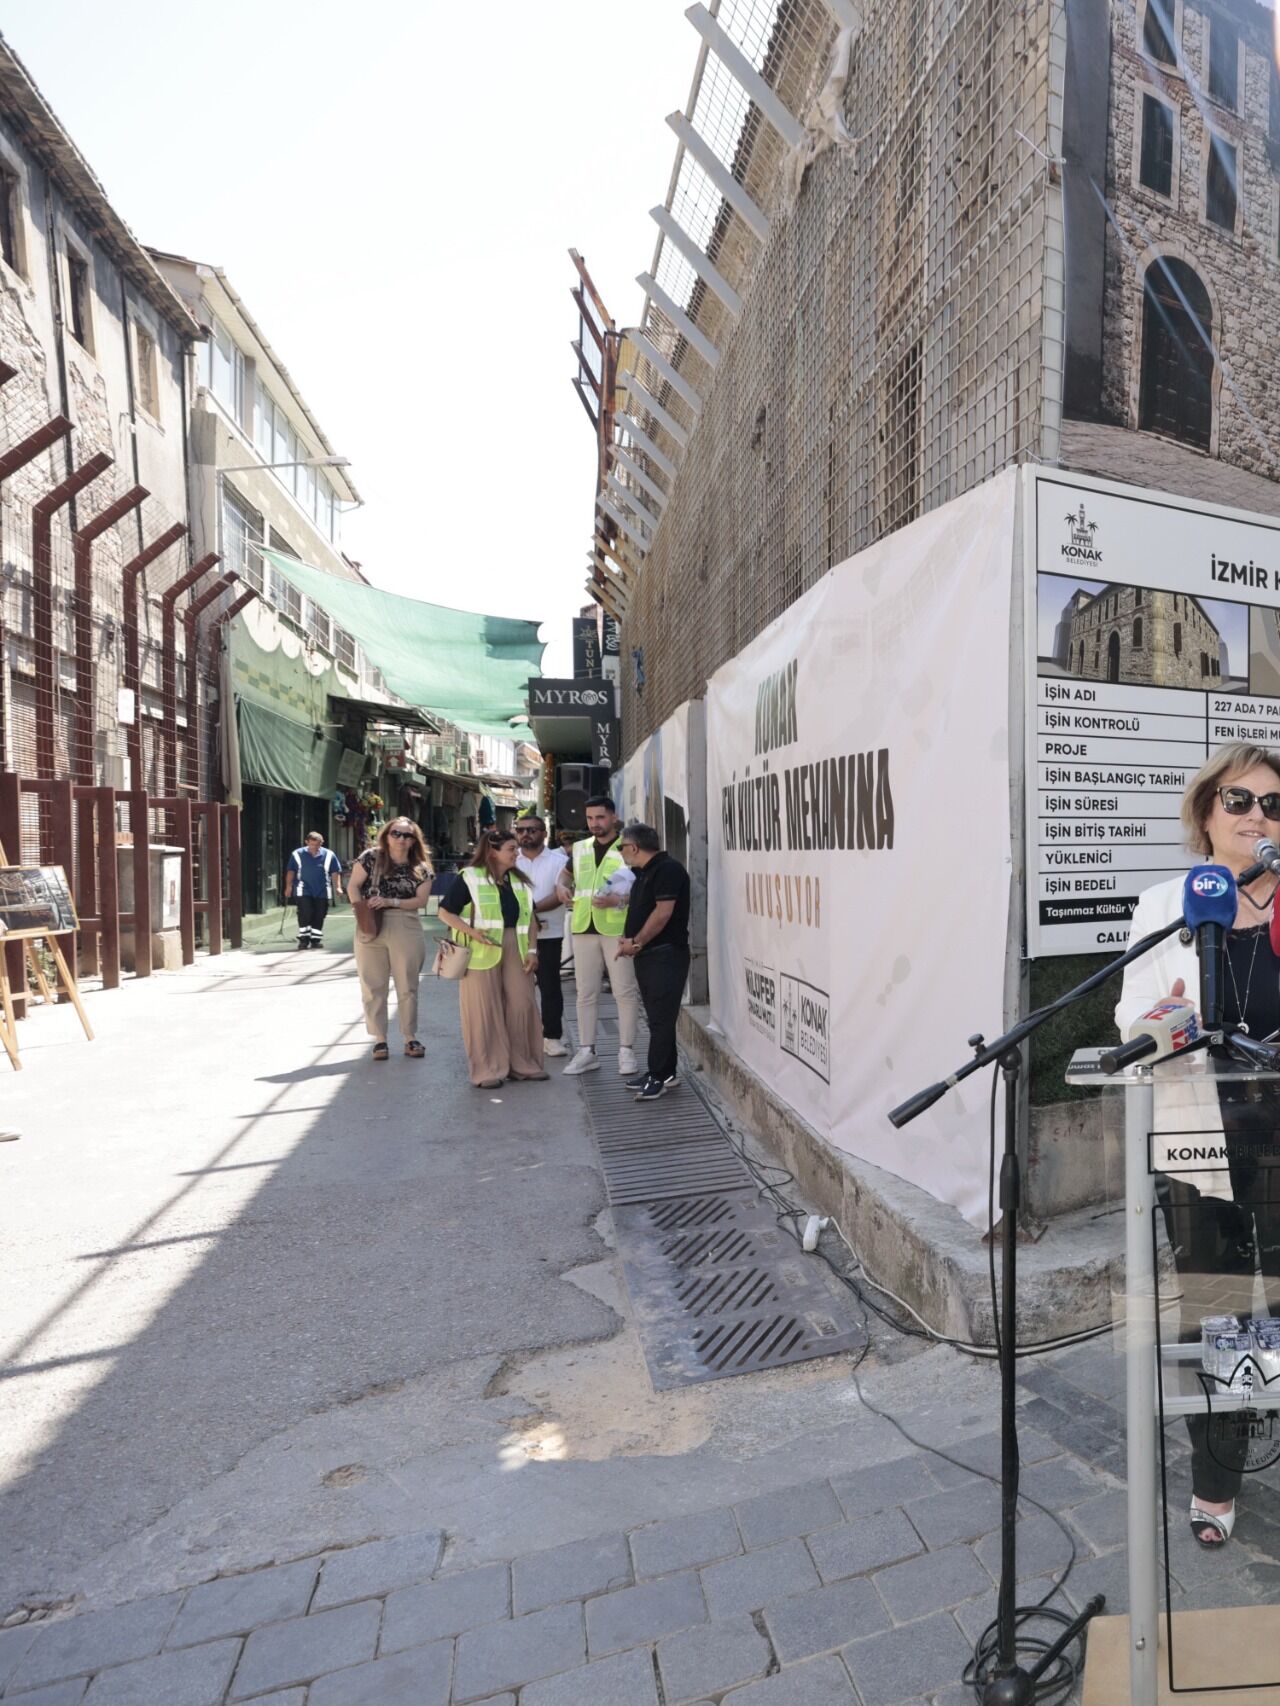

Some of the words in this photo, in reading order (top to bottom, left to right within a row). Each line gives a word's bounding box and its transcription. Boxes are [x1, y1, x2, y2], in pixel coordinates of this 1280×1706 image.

[1061, 544, 1103, 561] KONAK
[1211, 553, 1268, 589] İZMİR
[534, 689, 608, 705] MYROS
[1045, 684, 1071, 701] İŞİN
[1074, 689, 1096, 702] ADI
[755, 658, 798, 756] KONAK
[1215, 701, 1232, 712] 227
[1234, 703, 1257, 715] ADA
[1258, 705, 1264, 715] 7
[1045, 712, 1071, 729] İŞİN
[1074, 717, 1140, 732] KONTROLÜ
[1215, 726, 1235, 738] FEN
[1237, 725, 1268, 740] İŞLERİ
[597, 723, 612, 769] MYRO
[1045, 743, 1087, 756] PROJE
[1045, 770, 1071, 784] İŞİN
[1074, 772, 1147, 787] BAŞLANGIÇ
[1149, 771, 1185, 786] TARİHİ
[738, 759, 782, 852] KÜLTÜR
[784, 748, 894, 851] MEKANINA
[1045, 796, 1071, 811] İŞİN
[1074, 796, 1118, 811] SÜRESİ
[1045, 823, 1071, 839] İŞİN
[1074, 822, 1105, 839] BİTİŞ
[1110, 823, 1147, 838] TARİHİ
[1045, 849, 1112, 865] YÜKLENİCİ
[1045, 877, 1071, 893] İŞİN
[1074, 876, 1116, 891] BEDELİ
[746, 872, 820, 929] KAVUŞUYOR
[1046, 905, 1094, 918] Taşınmaz
[1096, 903, 1127, 915] Kültür
[801, 995, 827, 1040] KONAK
[1167, 1146, 1229, 1161] KONAK
